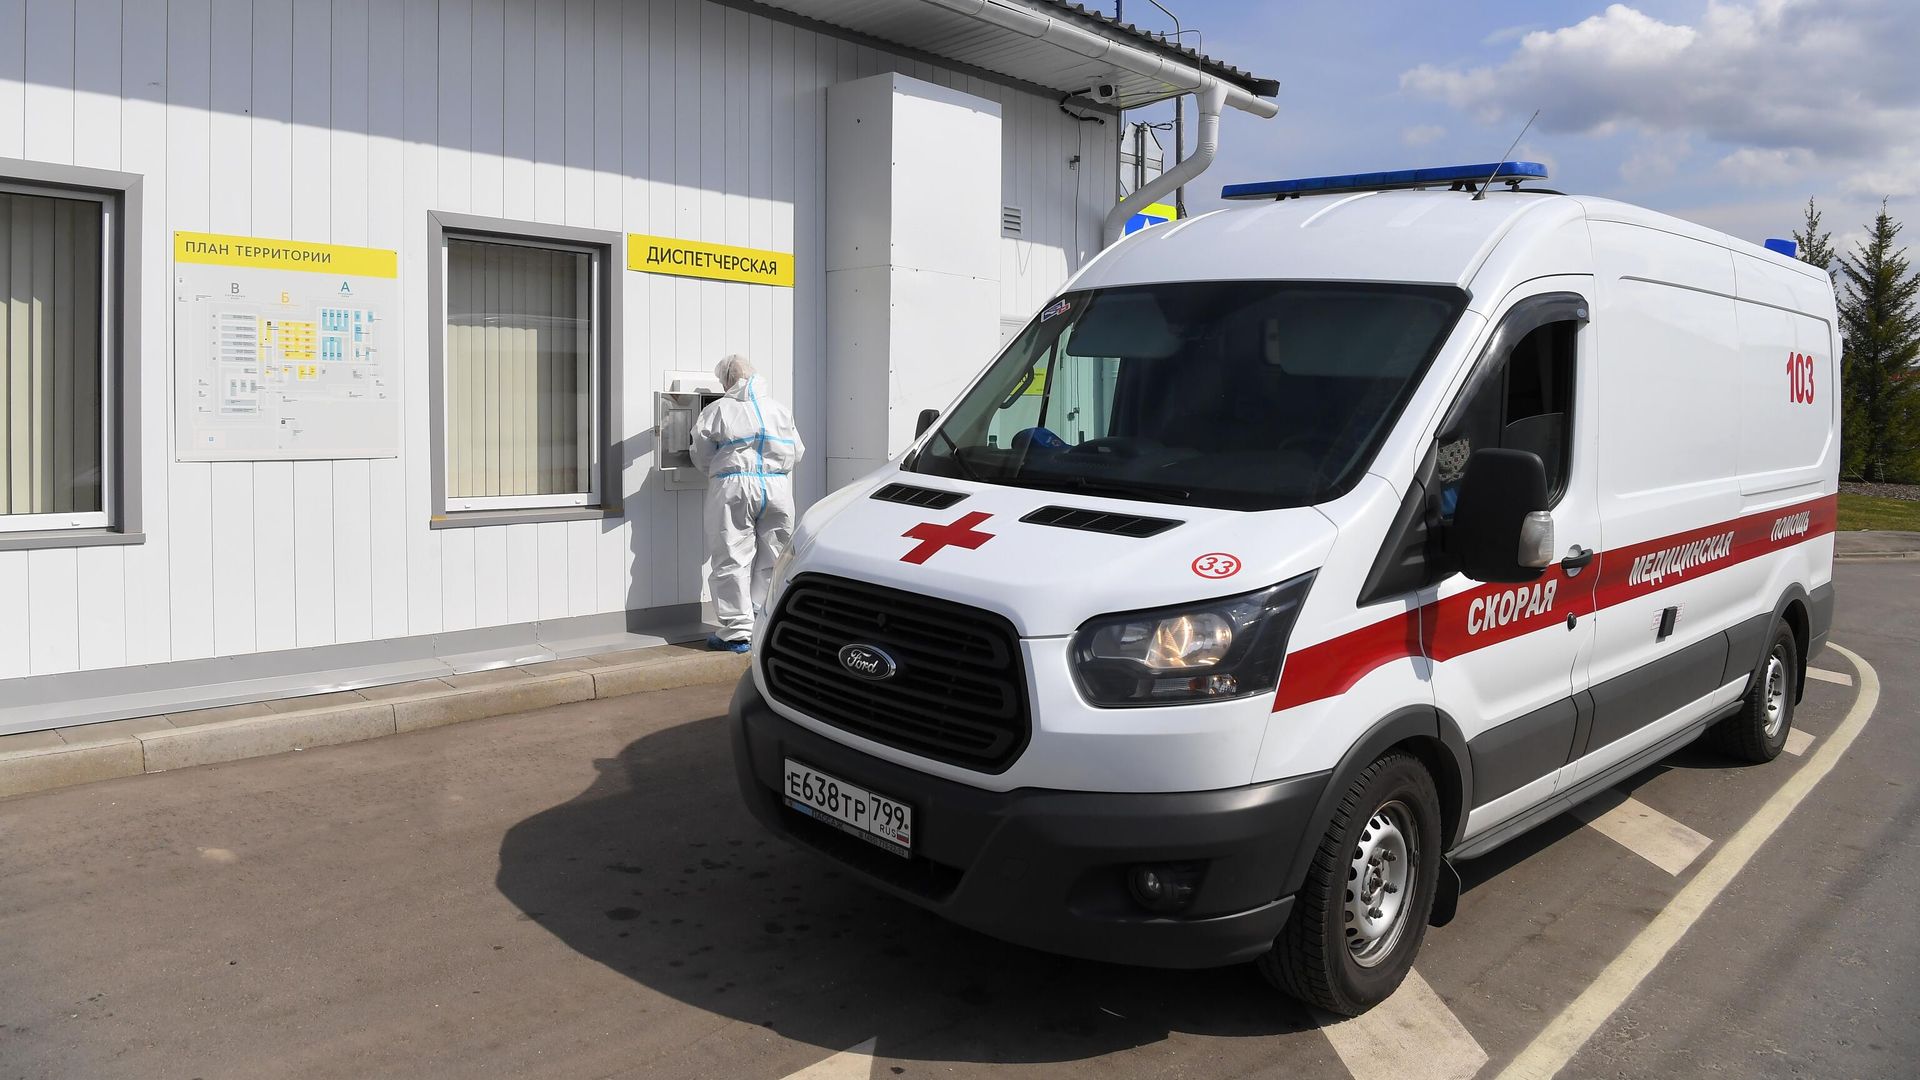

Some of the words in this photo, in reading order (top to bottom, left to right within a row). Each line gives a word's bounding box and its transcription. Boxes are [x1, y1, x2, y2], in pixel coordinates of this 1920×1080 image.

[185, 241, 229, 255] ПЛАН
[235, 245, 331, 263] ТЕРРИТОРИИ
[646, 246, 777, 275] ДИСПЕТЧЕРСКАЯ
[231, 282, 240, 294] В
[340, 281, 351, 293] А
[281, 291, 290, 304] Б
[1786, 351, 1815, 405] 103
[1198, 556, 1235, 575] 33
[1467, 579, 1557, 635] СКОРАЯ
[1628, 531, 1735, 586] МЕДИЦИНСКАЯ
[1770, 510, 1811, 542] ПОМОЩЬ
[846, 648, 879, 674] Ford
[879, 824, 897, 838] RUS
